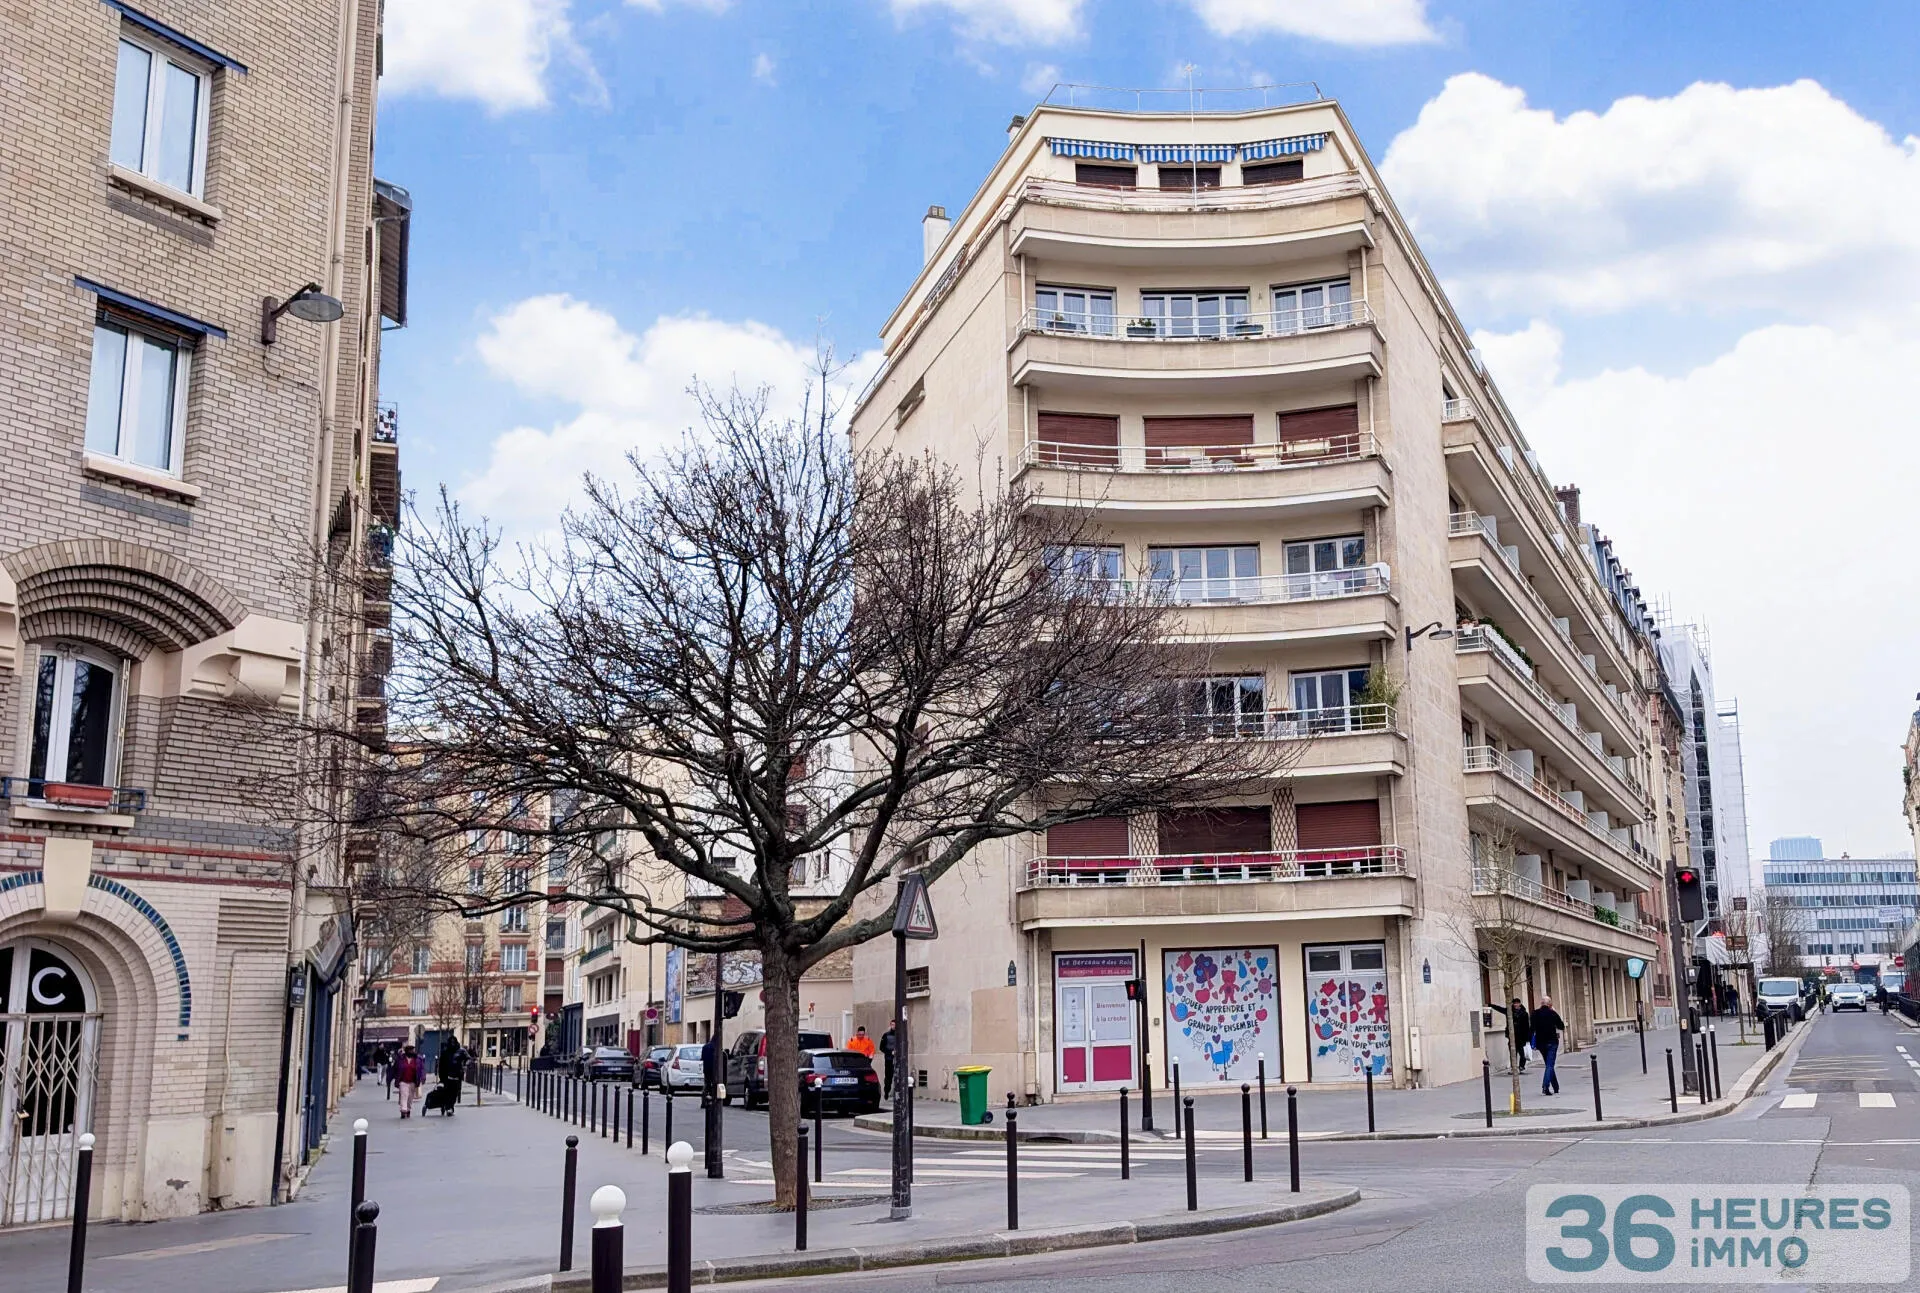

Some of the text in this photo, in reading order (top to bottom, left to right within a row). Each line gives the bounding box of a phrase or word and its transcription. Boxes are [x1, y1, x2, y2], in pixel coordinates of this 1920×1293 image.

[31, 966, 67, 1006] C
[1205, 1004, 1245, 1014] APPRENDRE
[1247, 1002, 1256, 1012] ET
[1187, 1018, 1259, 1034] GRANDIR ENSEMBLE
